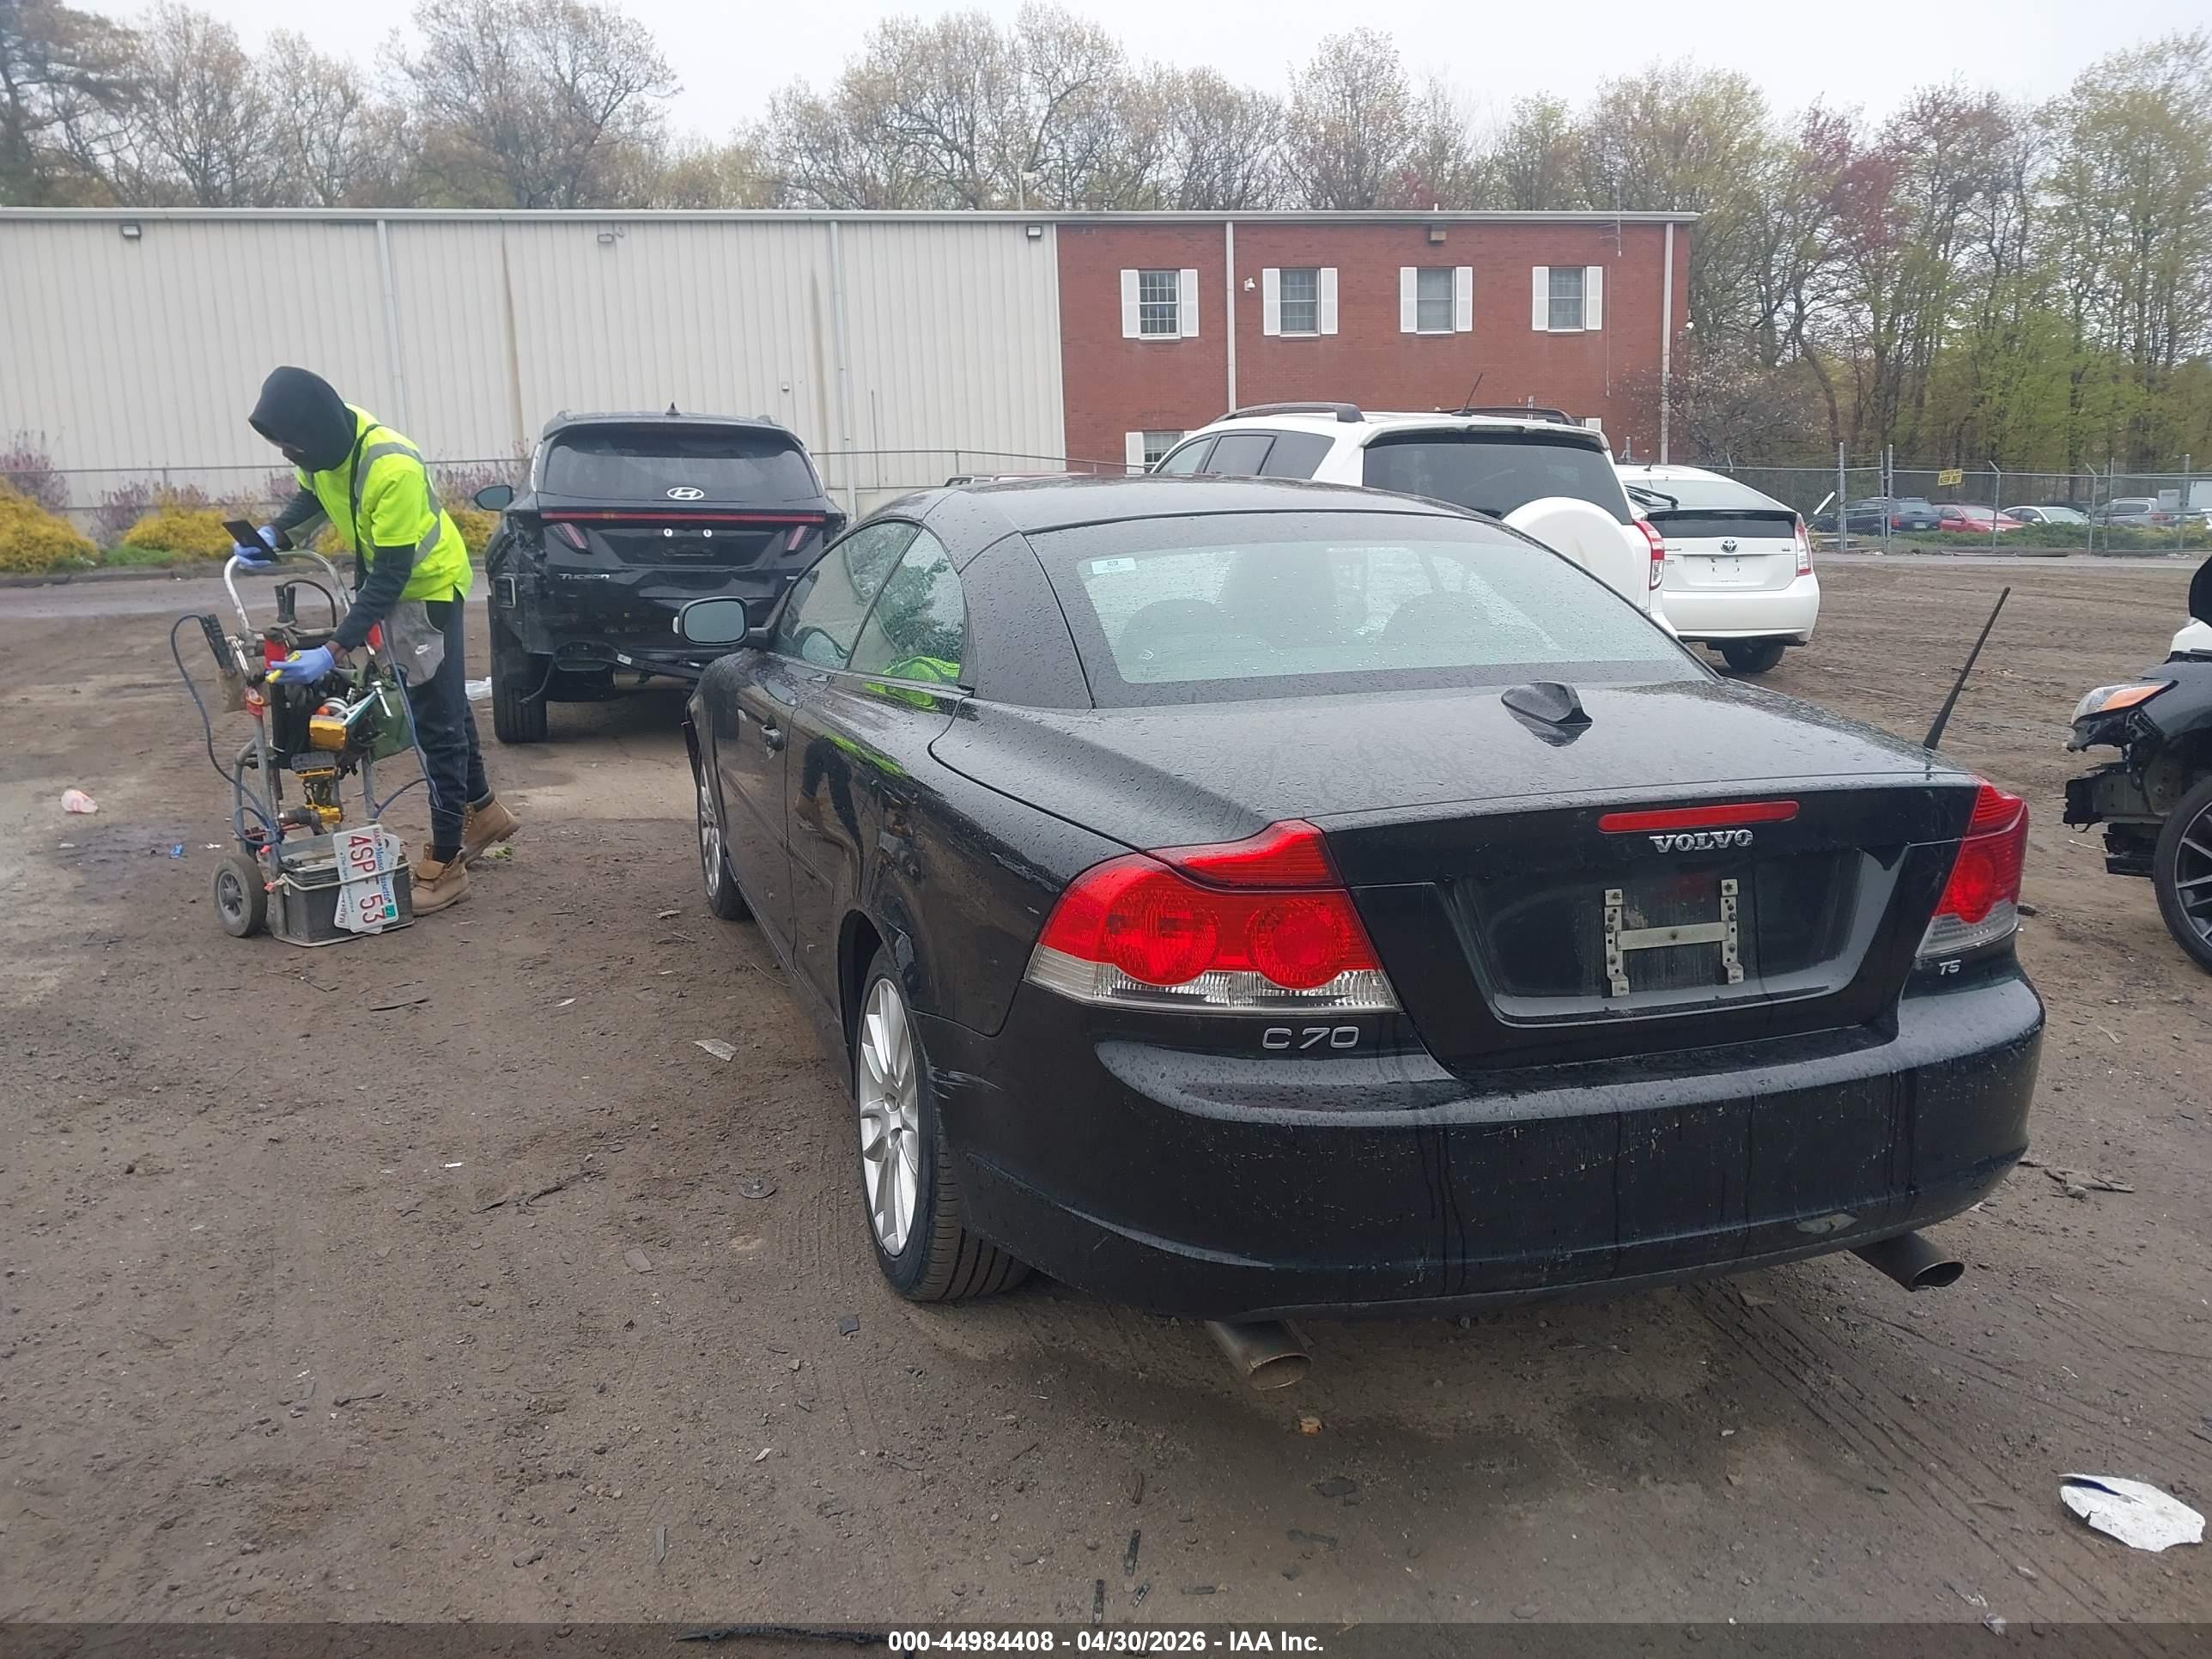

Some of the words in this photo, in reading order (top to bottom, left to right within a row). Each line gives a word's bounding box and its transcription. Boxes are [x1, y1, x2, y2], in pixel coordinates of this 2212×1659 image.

[1649, 829, 1753, 854] VOLVO
[375, 847, 390, 900] Massausetts
[359, 893, 386, 923] 53
[1939, 959, 1961, 975] T5
[1262, 1026, 1359, 1049] C70
